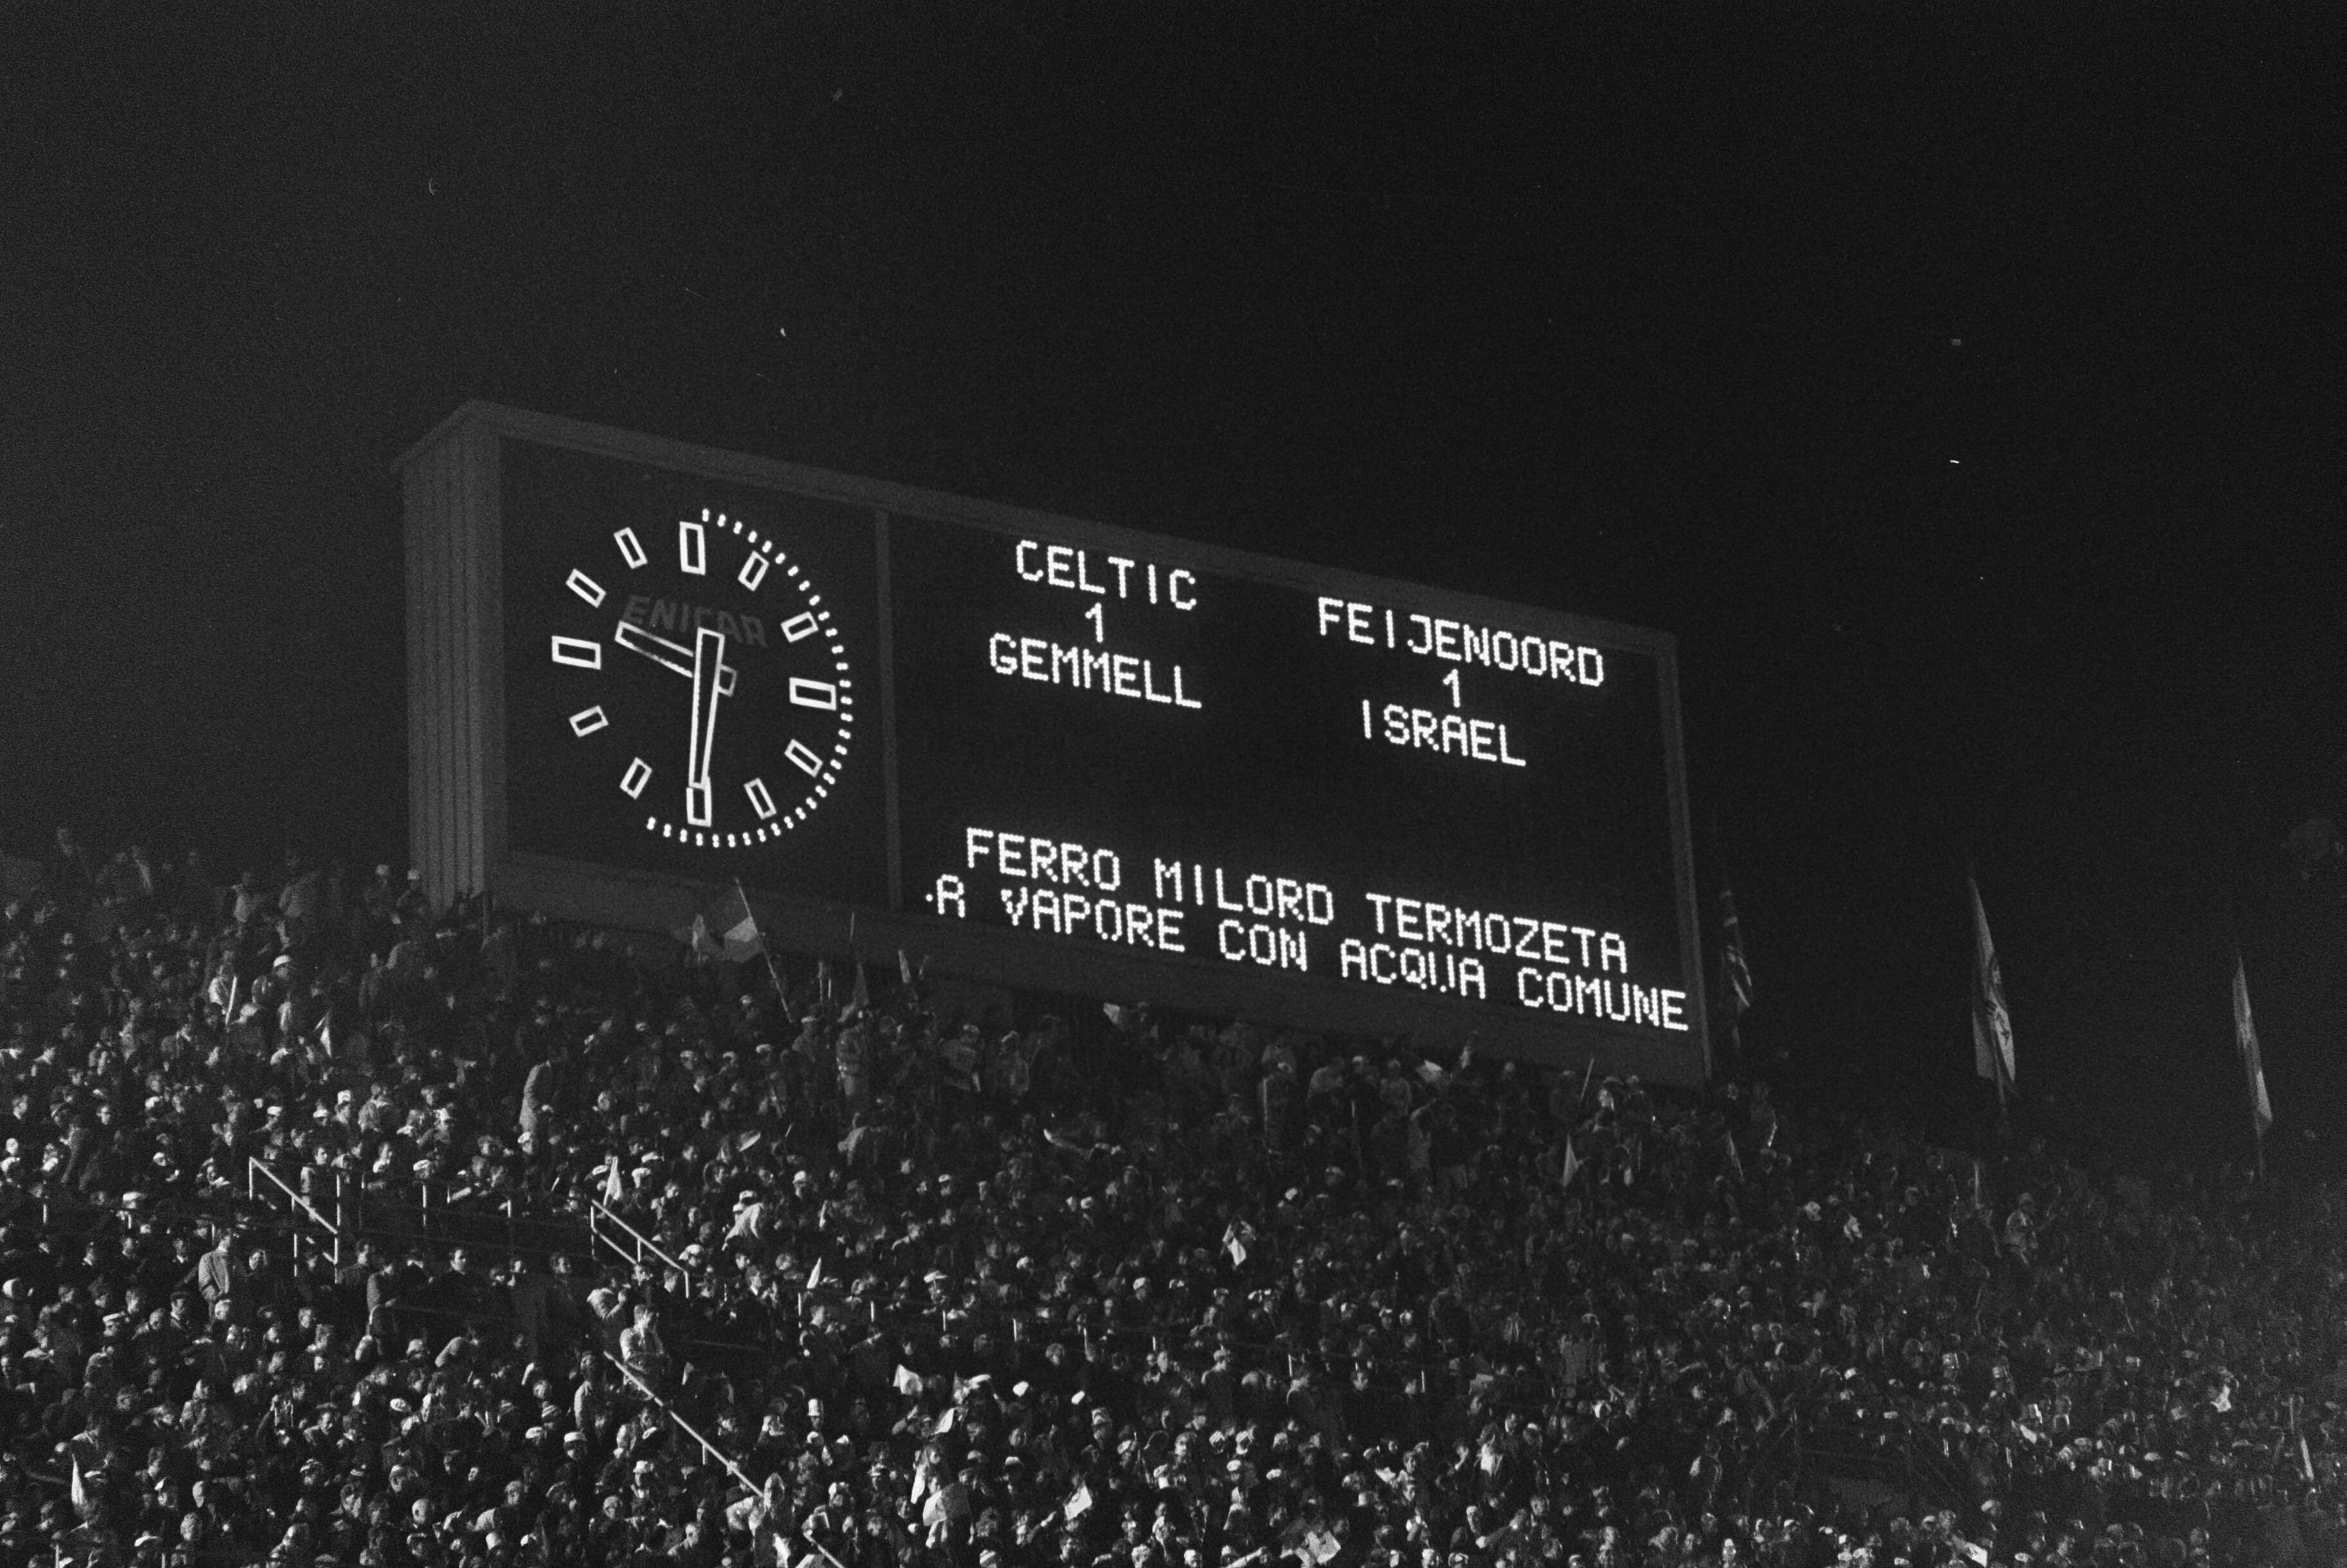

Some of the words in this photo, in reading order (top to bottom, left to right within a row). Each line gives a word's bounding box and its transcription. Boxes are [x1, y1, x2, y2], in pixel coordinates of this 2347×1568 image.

[1016, 539, 1197, 611] CELTIC
[1084, 602, 1104, 644] 1
[1318, 596, 1605, 687] FEIJENOORD
[989, 632, 1202, 709] GEMMELL
[1442, 668, 1461, 708] 1
[1362, 699, 1527, 767] ISRAEL
[966, 826, 1121, 892] FERRO
[1154, 857, 1335, 926] MILORD
[1365, 892, 1628, 974] TERMOZETA
[1000, 886, 1185, 953] VAPORE
[1218, 919, 1308, 972] CON
[1340, 937, 1486, 1000] ACQUA
[1517, 966, 1689, 1032] COMUNE
